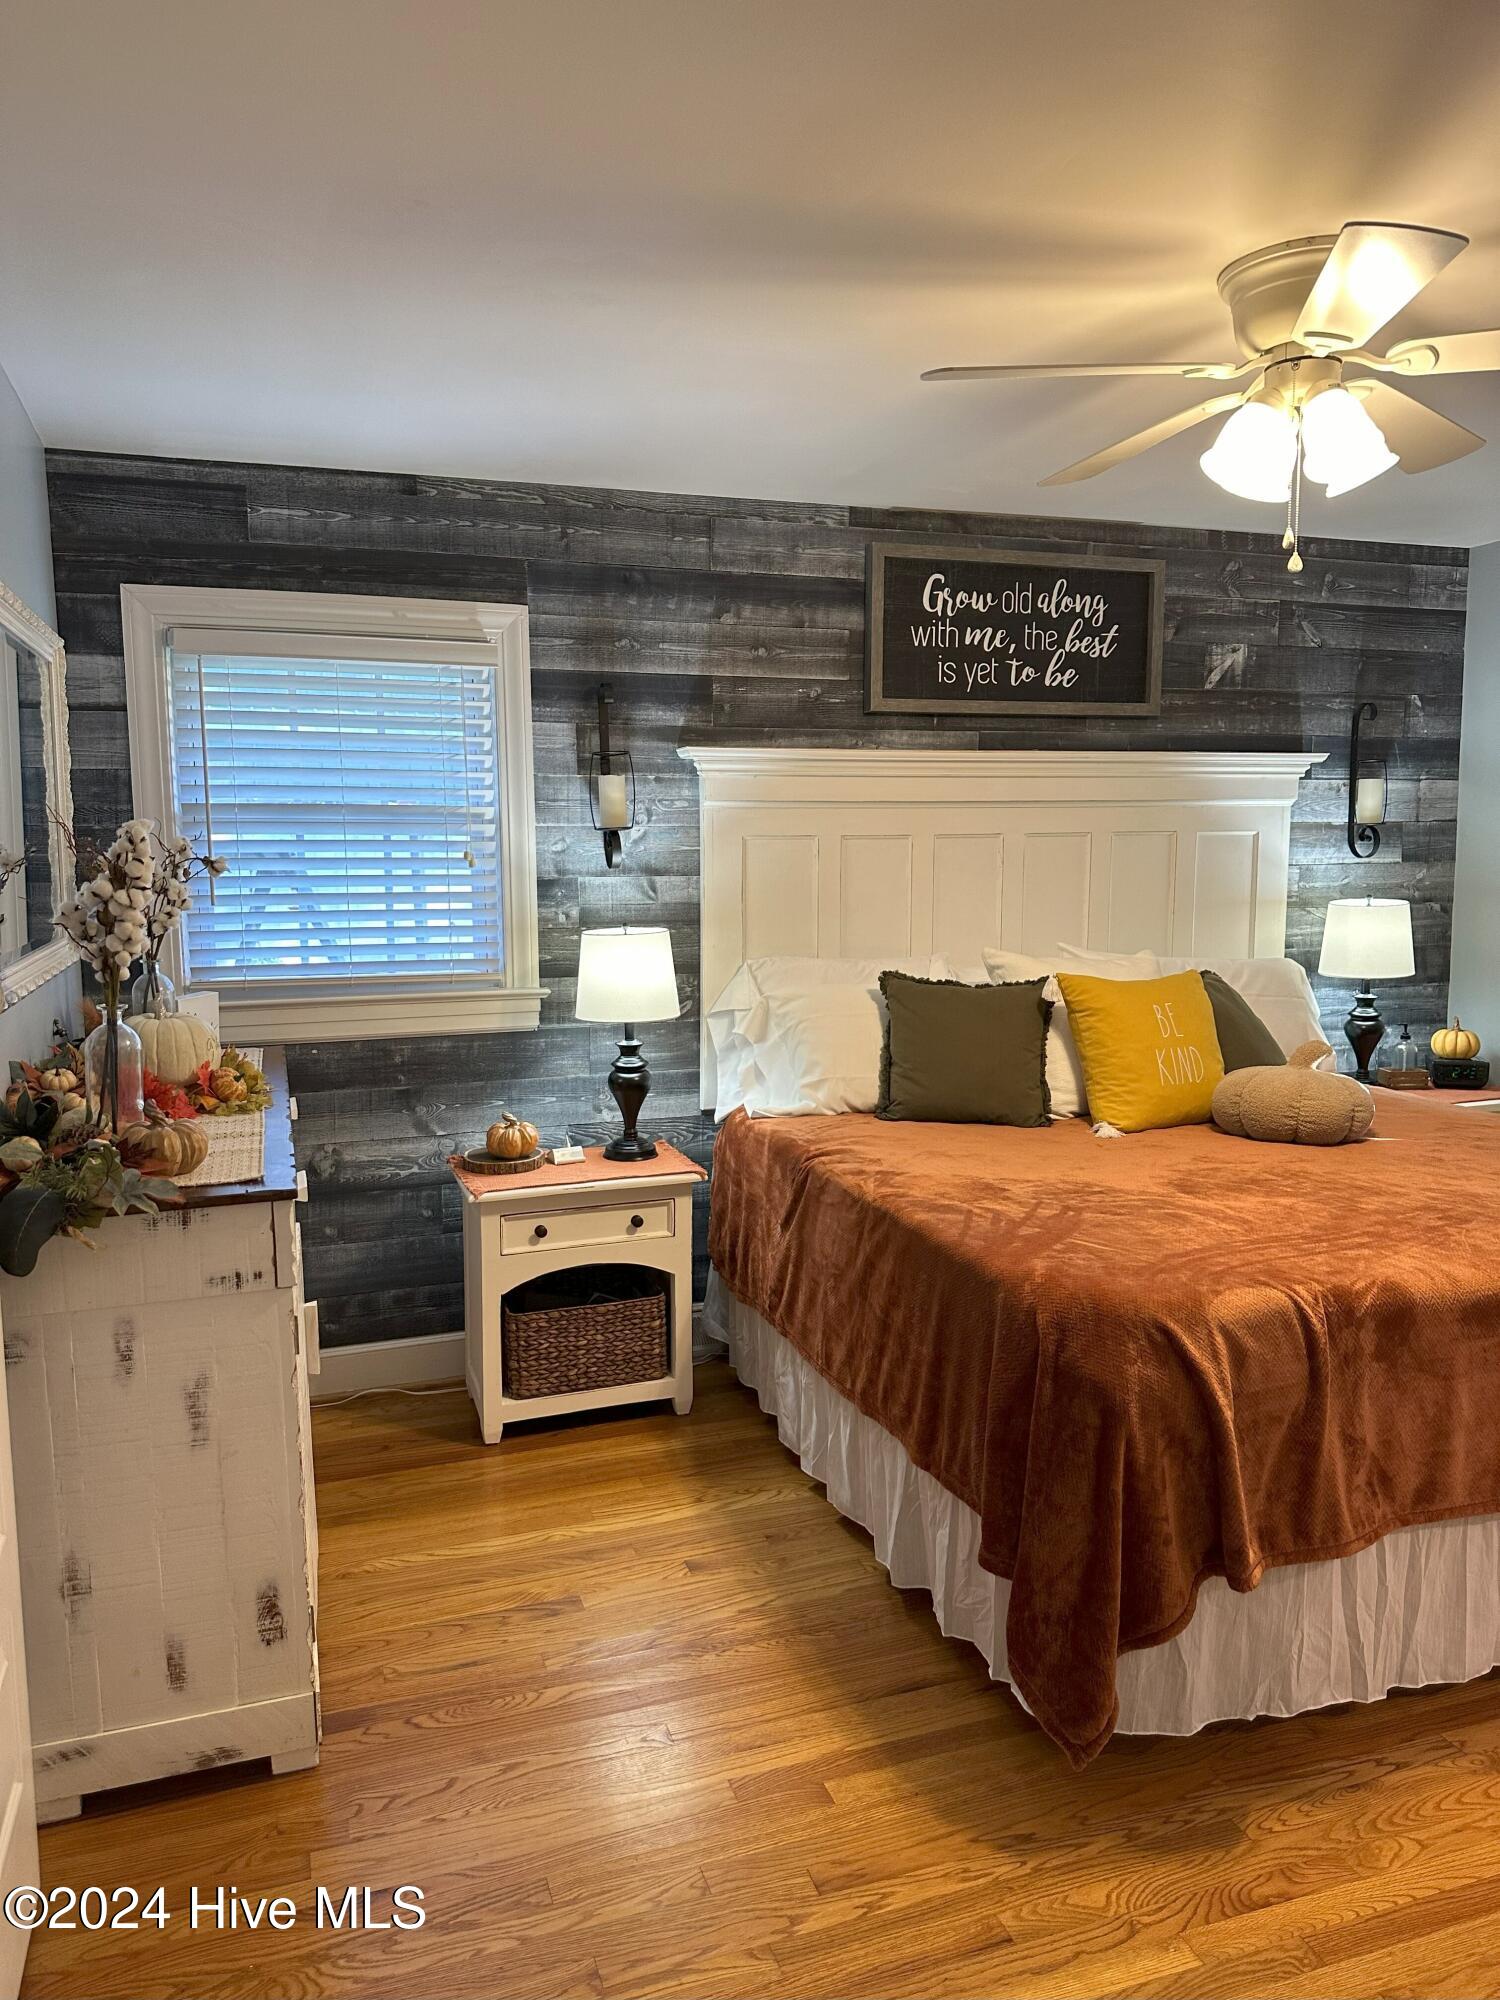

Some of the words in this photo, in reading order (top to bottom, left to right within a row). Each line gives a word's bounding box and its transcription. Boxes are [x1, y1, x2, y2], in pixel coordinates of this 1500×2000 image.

[922, 573, 998, 617] Grow
[1002, 582, 1032, 614] old
[1037, 578, 1108, 627] along
[911, 618, 958, 648] with
[964, 626, 1016, 654] me,
[1024, 622, 1058, 650] the
[1064, 618, 1119, 658] best
[938, 655, 957, 683] is
[963, 658, 999, 692] yet
[1005, 657, 1040, 686] to
[1044, 649, 1080, 688] be
[1153, 1002, 1184, 1038] BE
[1155, 1046, 1204, 1086] KIND
